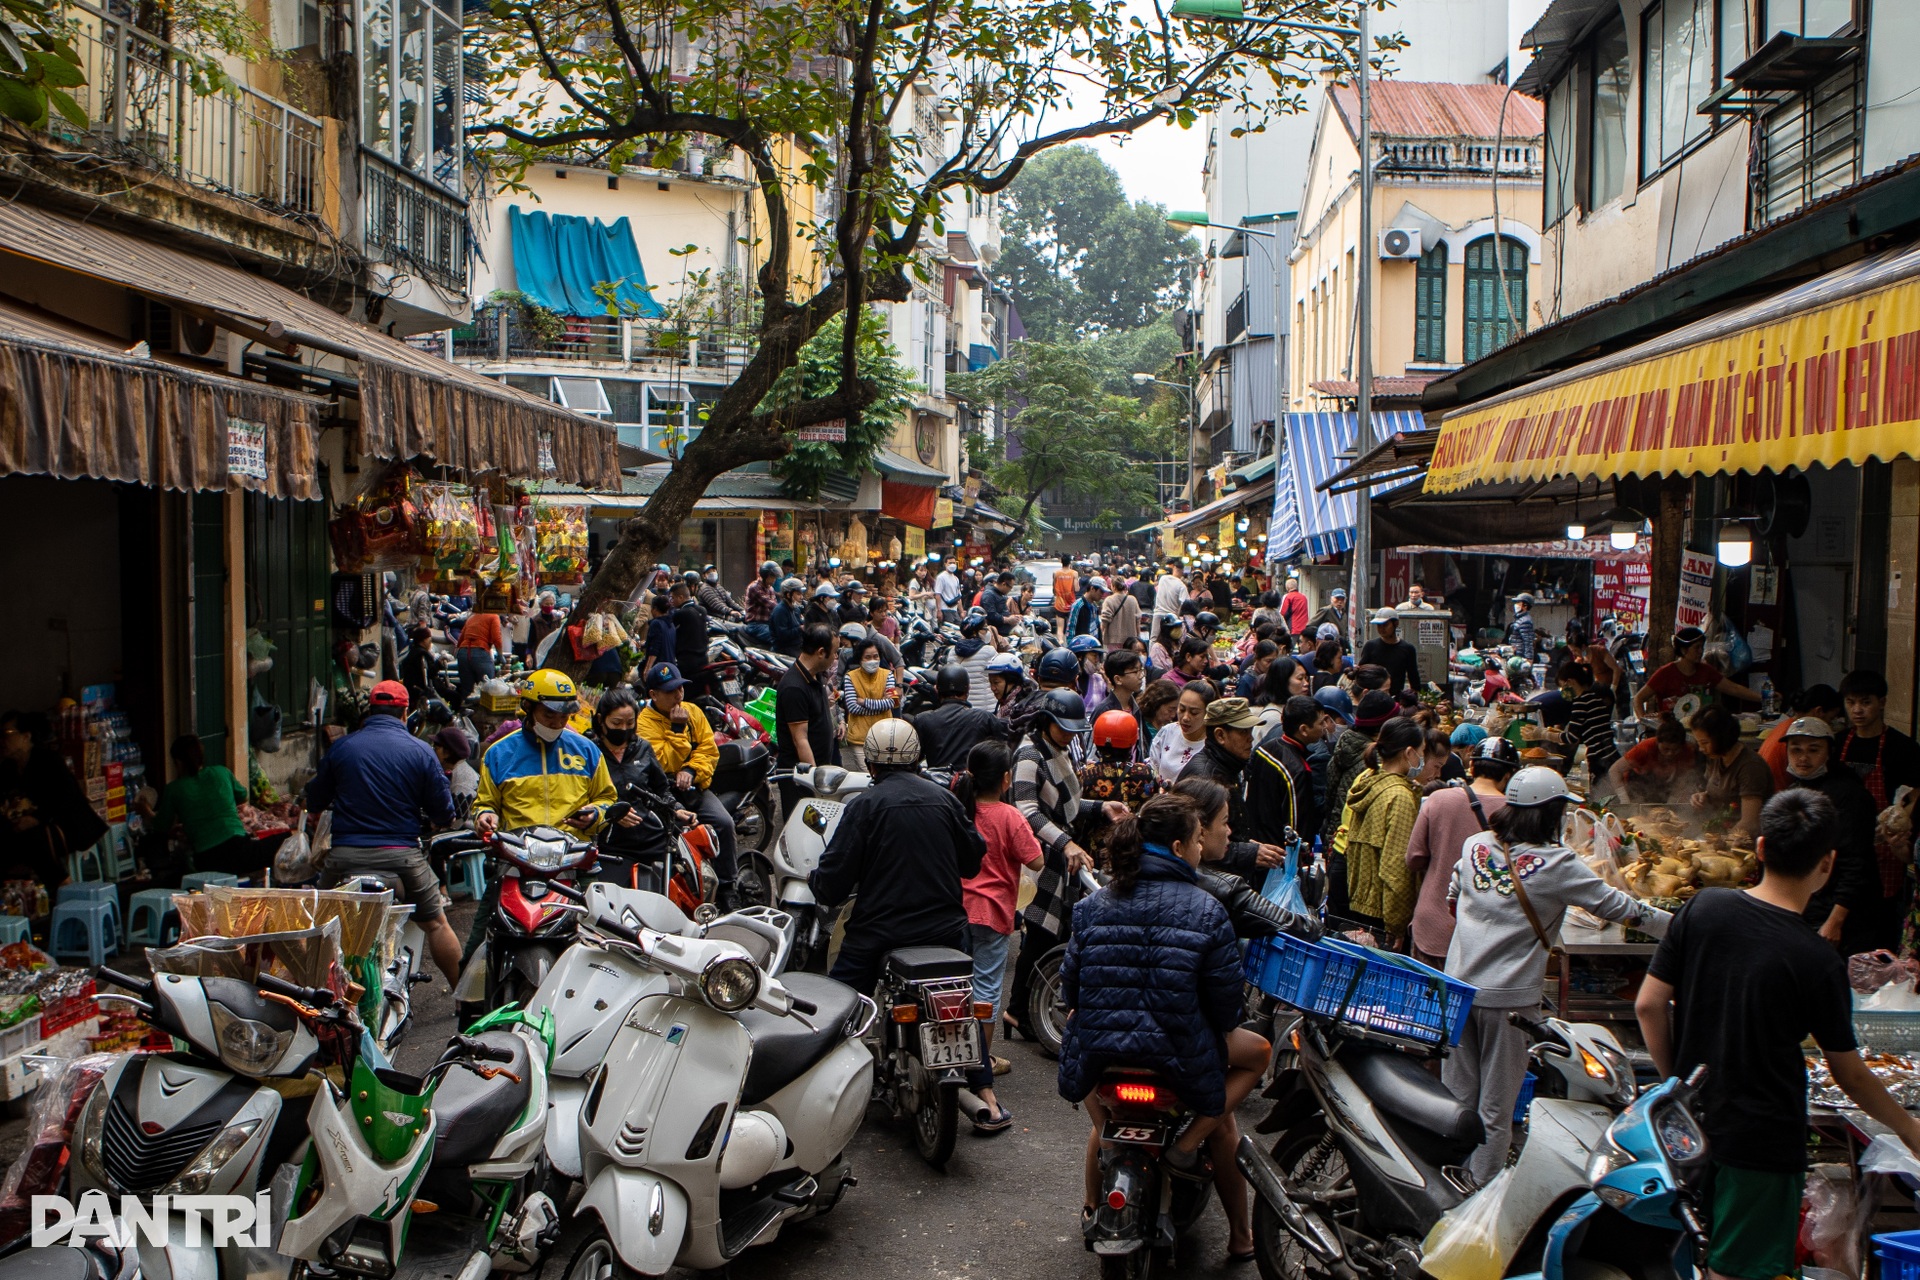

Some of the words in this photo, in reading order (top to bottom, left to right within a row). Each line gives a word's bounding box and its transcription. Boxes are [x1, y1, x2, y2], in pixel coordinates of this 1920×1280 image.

[556, 681, 572, 693] be
[559, 748, 586, 771] be
[931, 1043, 973, 1064] 2343
[1113, 1127, 1155, 1140] 133
